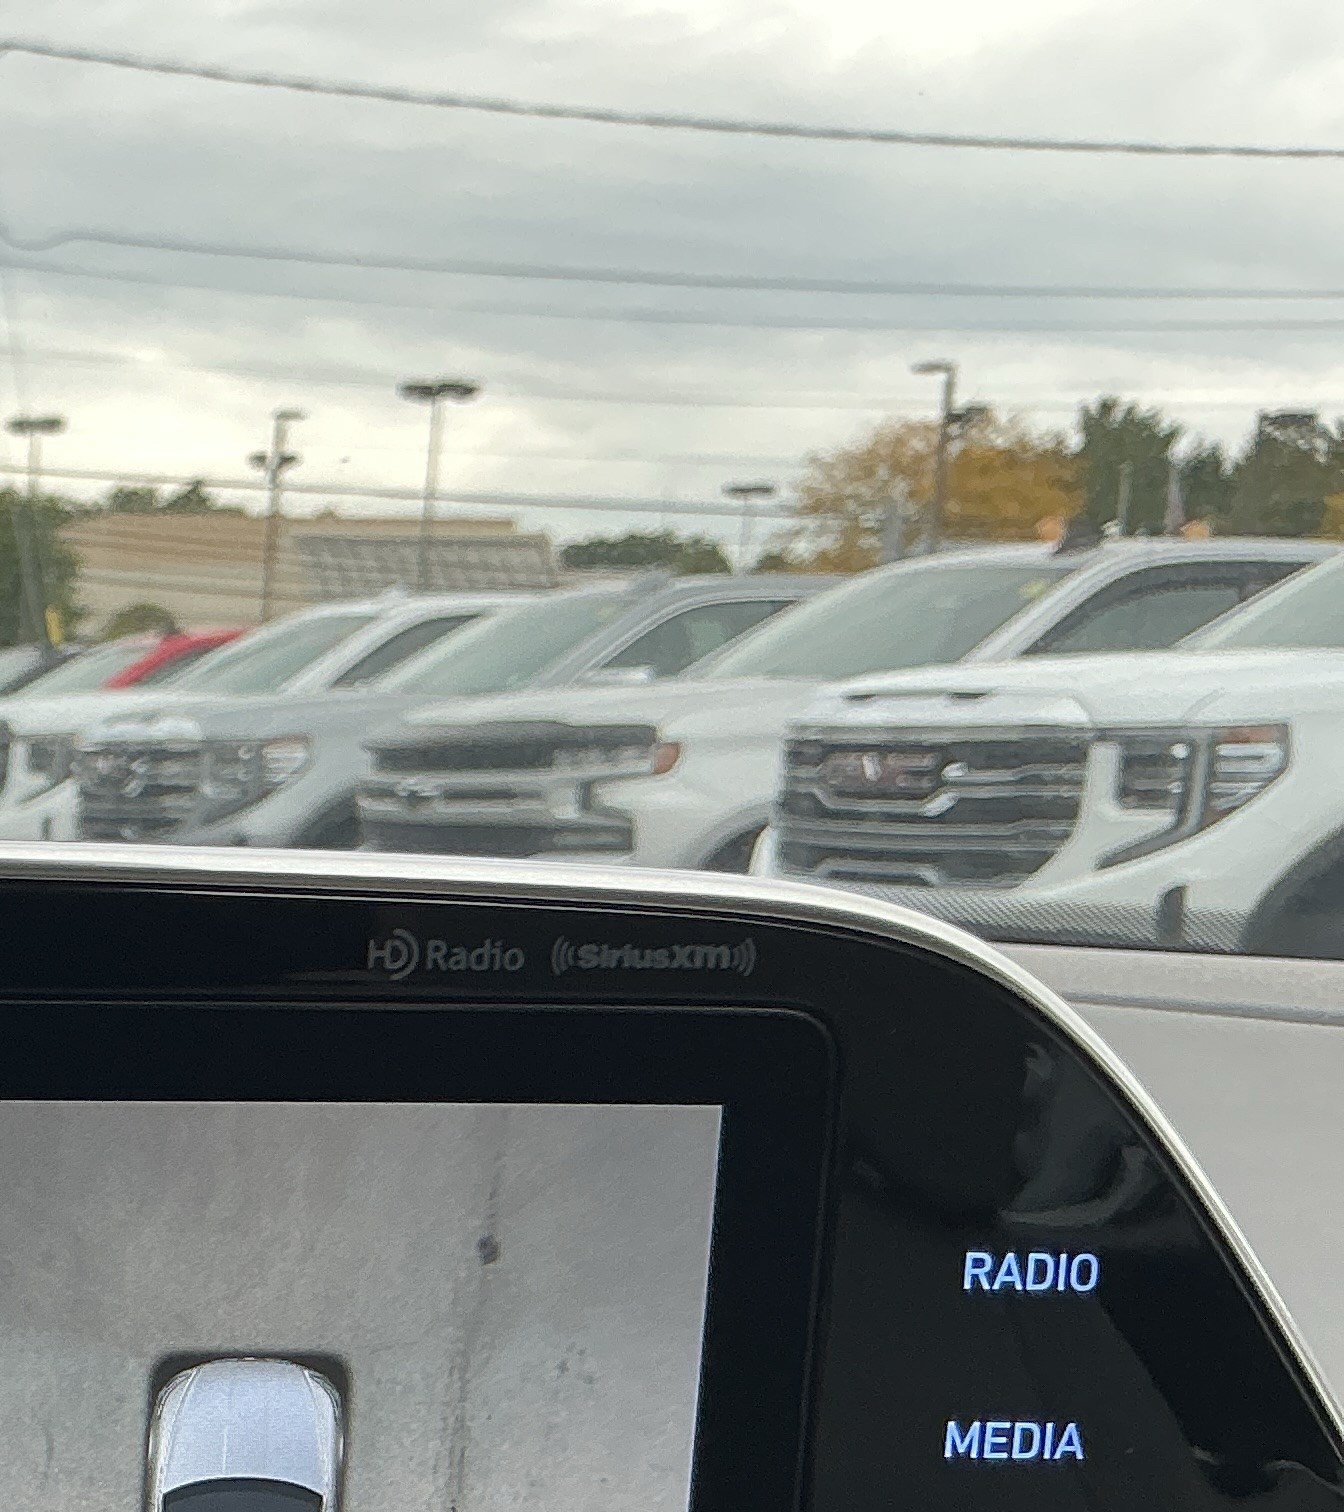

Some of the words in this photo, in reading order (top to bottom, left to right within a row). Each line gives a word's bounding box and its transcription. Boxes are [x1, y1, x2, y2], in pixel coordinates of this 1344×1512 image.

[426, 938, 525, 972] Radio
[962, 1251, 1100, 1293] RADIO
[943, 1420, 1085, 1462] MEDIA
